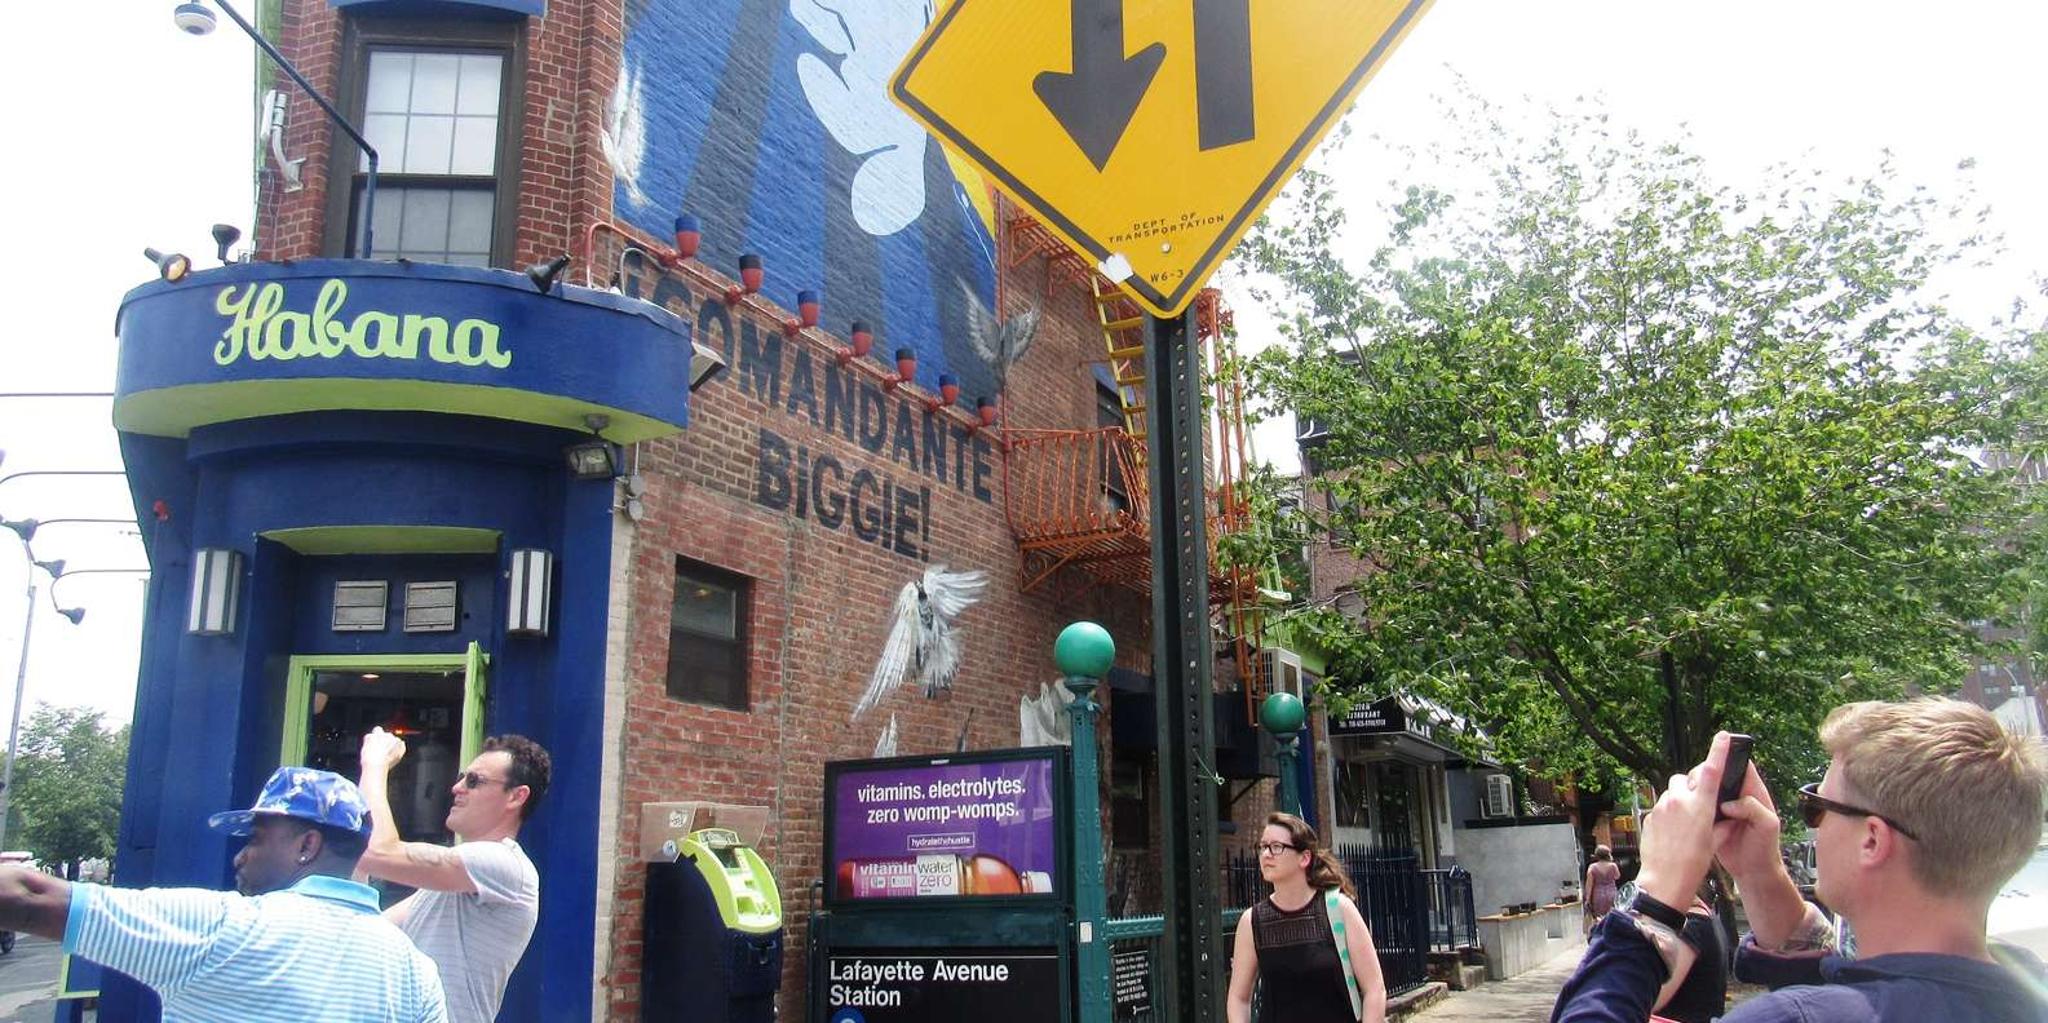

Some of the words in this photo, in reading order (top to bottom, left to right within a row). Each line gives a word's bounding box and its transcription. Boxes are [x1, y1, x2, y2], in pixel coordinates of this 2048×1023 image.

[1109, 214, 1225, 243] TRANSPORTATION
[1133, 218, 1166, 231] DEPT
[1181, 212, 1197, 222] OF
[1150, 269, 1184, 282] W6-3
[214, 278, 513, 369] Habana
[757, 427, 932, 563] BIGGIE!
[858, 782, 926, 803] vitamins.
[929, 777, 1026, 799] electrolytes.
[867, 809, 900, 824] zero
[904, 801, 1019, 825] womp-womps.
[860, 862, 917, 876] vitamin
[918, 860, 954, 874] water
[919, 874, 952, 888] zero
[830, 960, 925, 985] Lafayette
[932, 960, 1009, 981] Avenue
[829, 984, 901, 1006] Station
